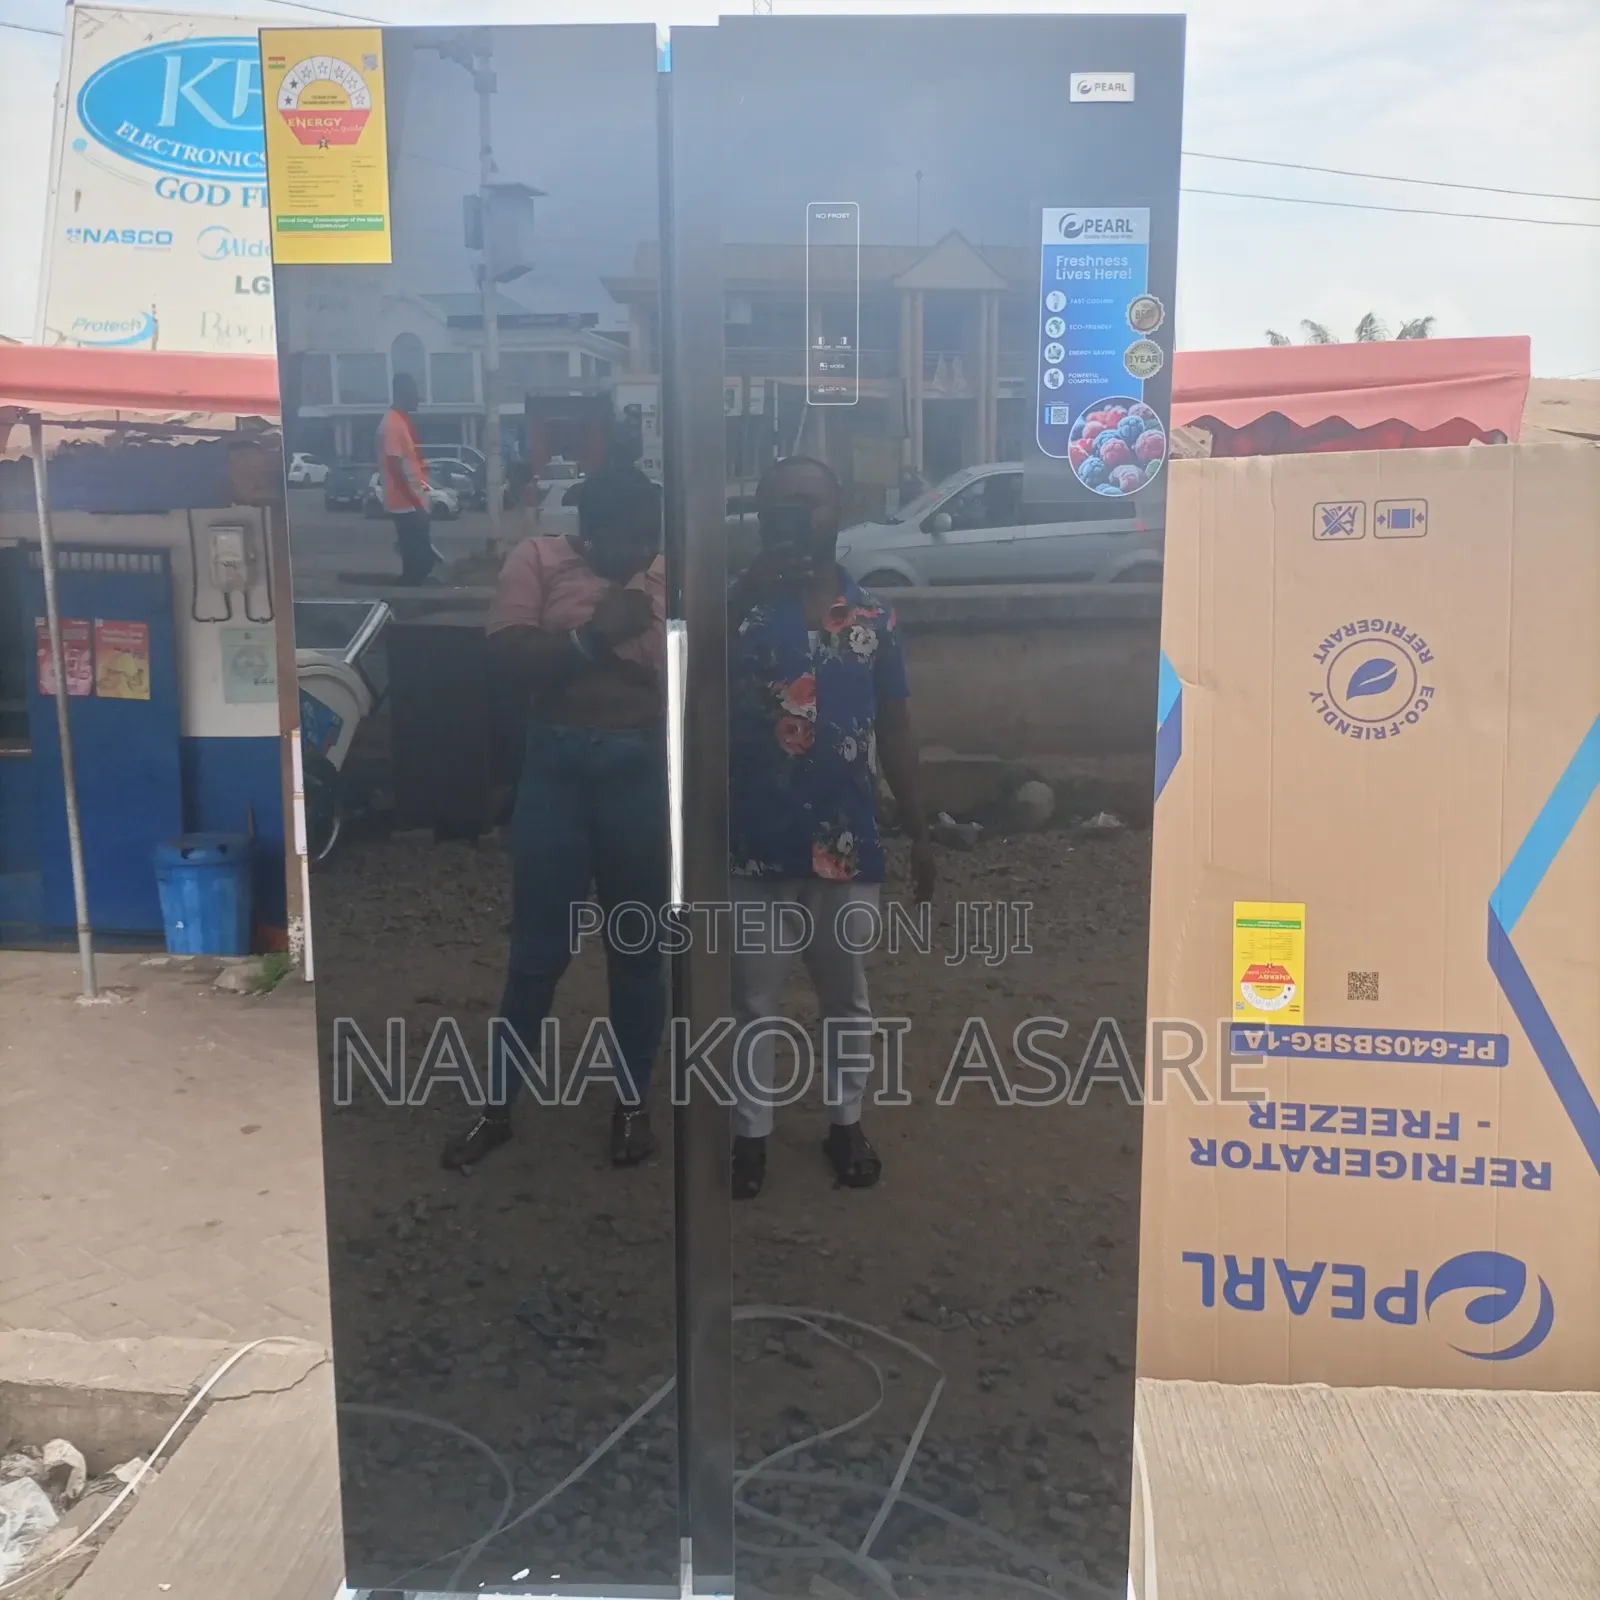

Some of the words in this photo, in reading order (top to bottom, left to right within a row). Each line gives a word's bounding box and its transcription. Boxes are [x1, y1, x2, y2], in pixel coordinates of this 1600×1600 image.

[1094, 82, 1127, 92] PEARL
[287, 116, 342, 129] ENERGY
[155, 176, 231, 207] GOD
[1084, 219, 1133, 233] PEARL
[83, 228, 173, 245] NASCO
[1056, 255, 1129, 267] Freshness
[1056, 268, 1091, 280] Lives
[1095, 268, 1132, 280] Here!
[234, 275, 271, 294] LG
[71, 316, 142, 333] Protech
[1134, 355, 1157, 363] YEAR
[1312, 618, 1434, 665] REFRIGERANT
[1309, 685, 1435, 740] ECO-FRIENDLY
[1243, 1029, 1496, 1061] PF-640SBSBG-1A
[1247, 1101, 1460, 1141] FREEZER
[1188, 1137, 1552, 1191] REFRIGERATOR
[1182, 1250, 1419, 1325] PEARL
